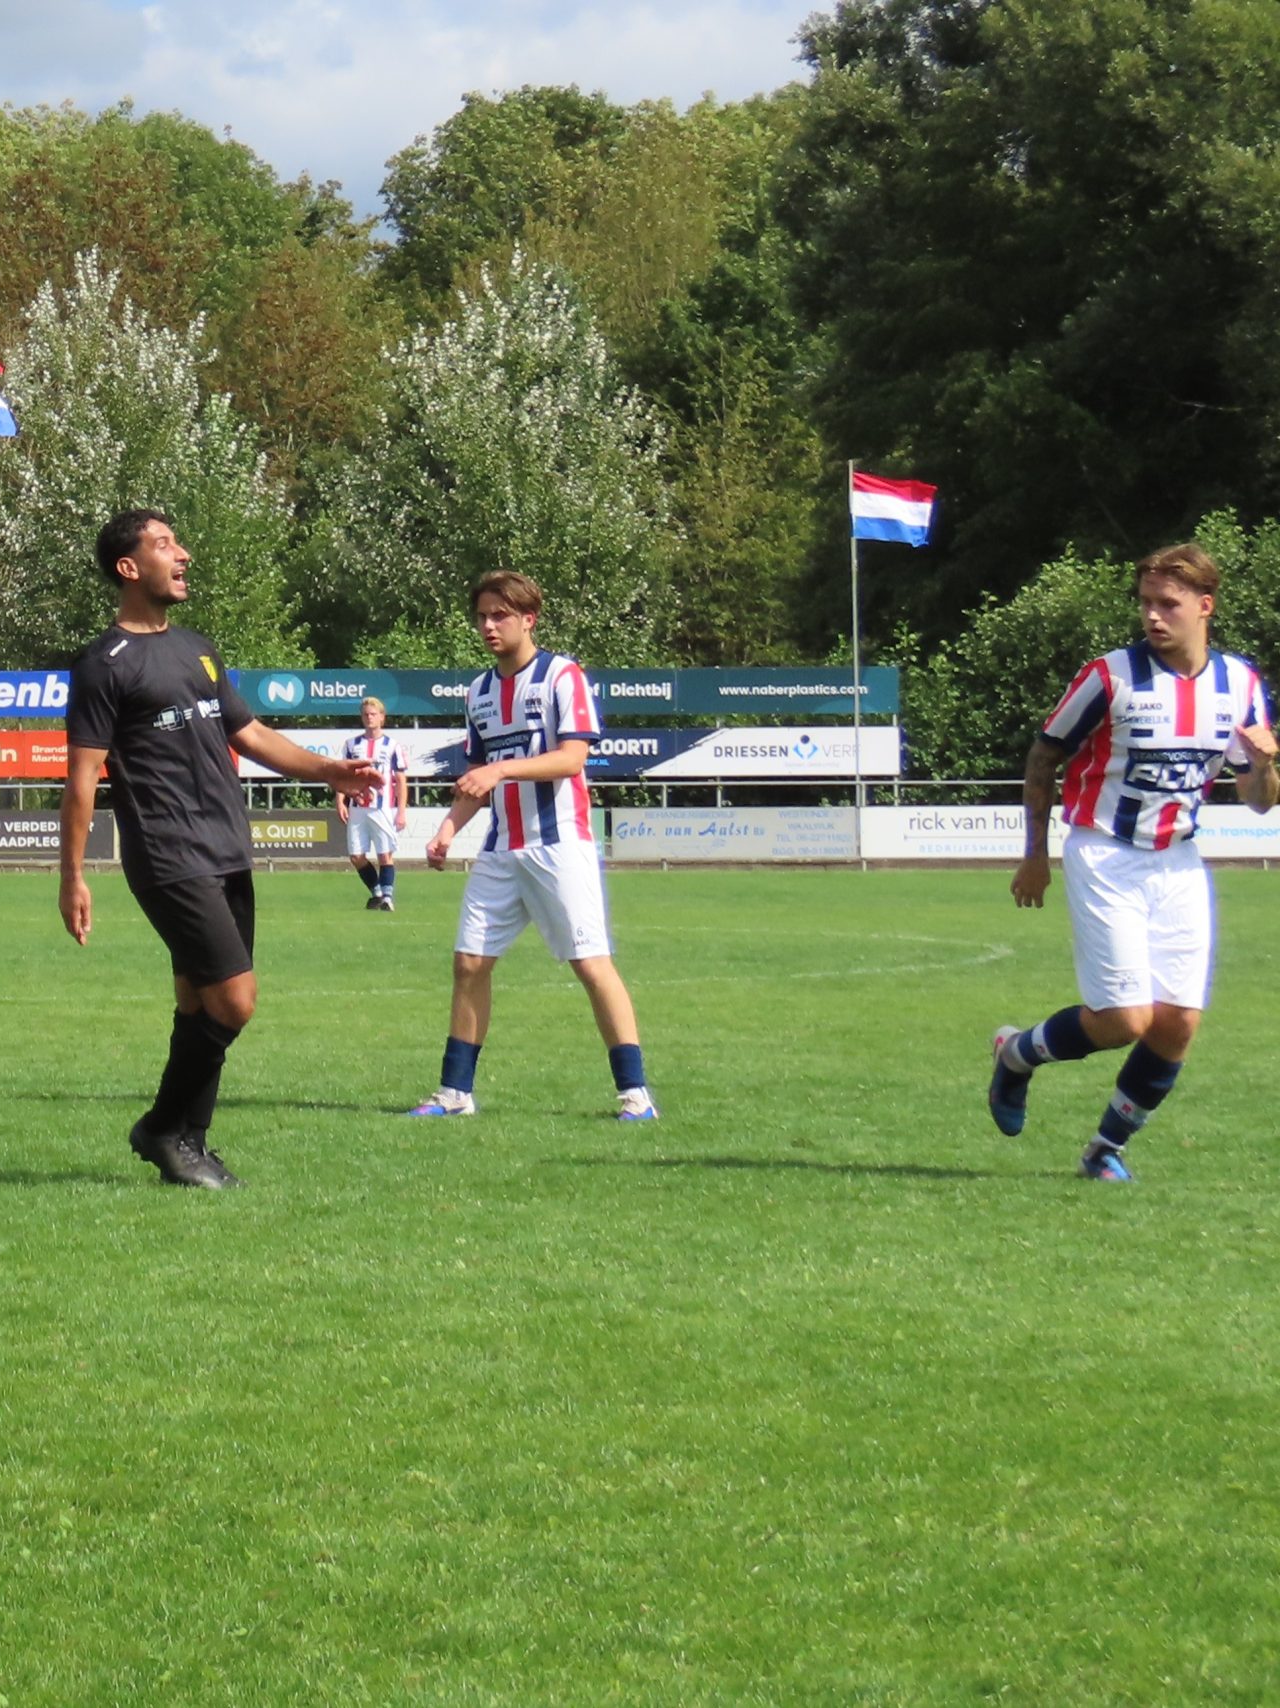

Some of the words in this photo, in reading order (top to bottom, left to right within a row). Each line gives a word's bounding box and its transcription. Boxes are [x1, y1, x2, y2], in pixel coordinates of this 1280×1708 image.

[310, 681, 366, 697] Naber
[610, 683, 672, 700] Dichtbij
[718, 684, 868, 698] www.naberplastics.com
[713, 745, 789, 758] DRIESSEN
[909, 811, 945, 830] rick
[951, 818, 987, 830] van
[251, 826, 263, 838] &
[615, 822, 656, 839] Gebr.
[664, 826, 693, 836] van
[698, 822, 749, 836] Aalst
